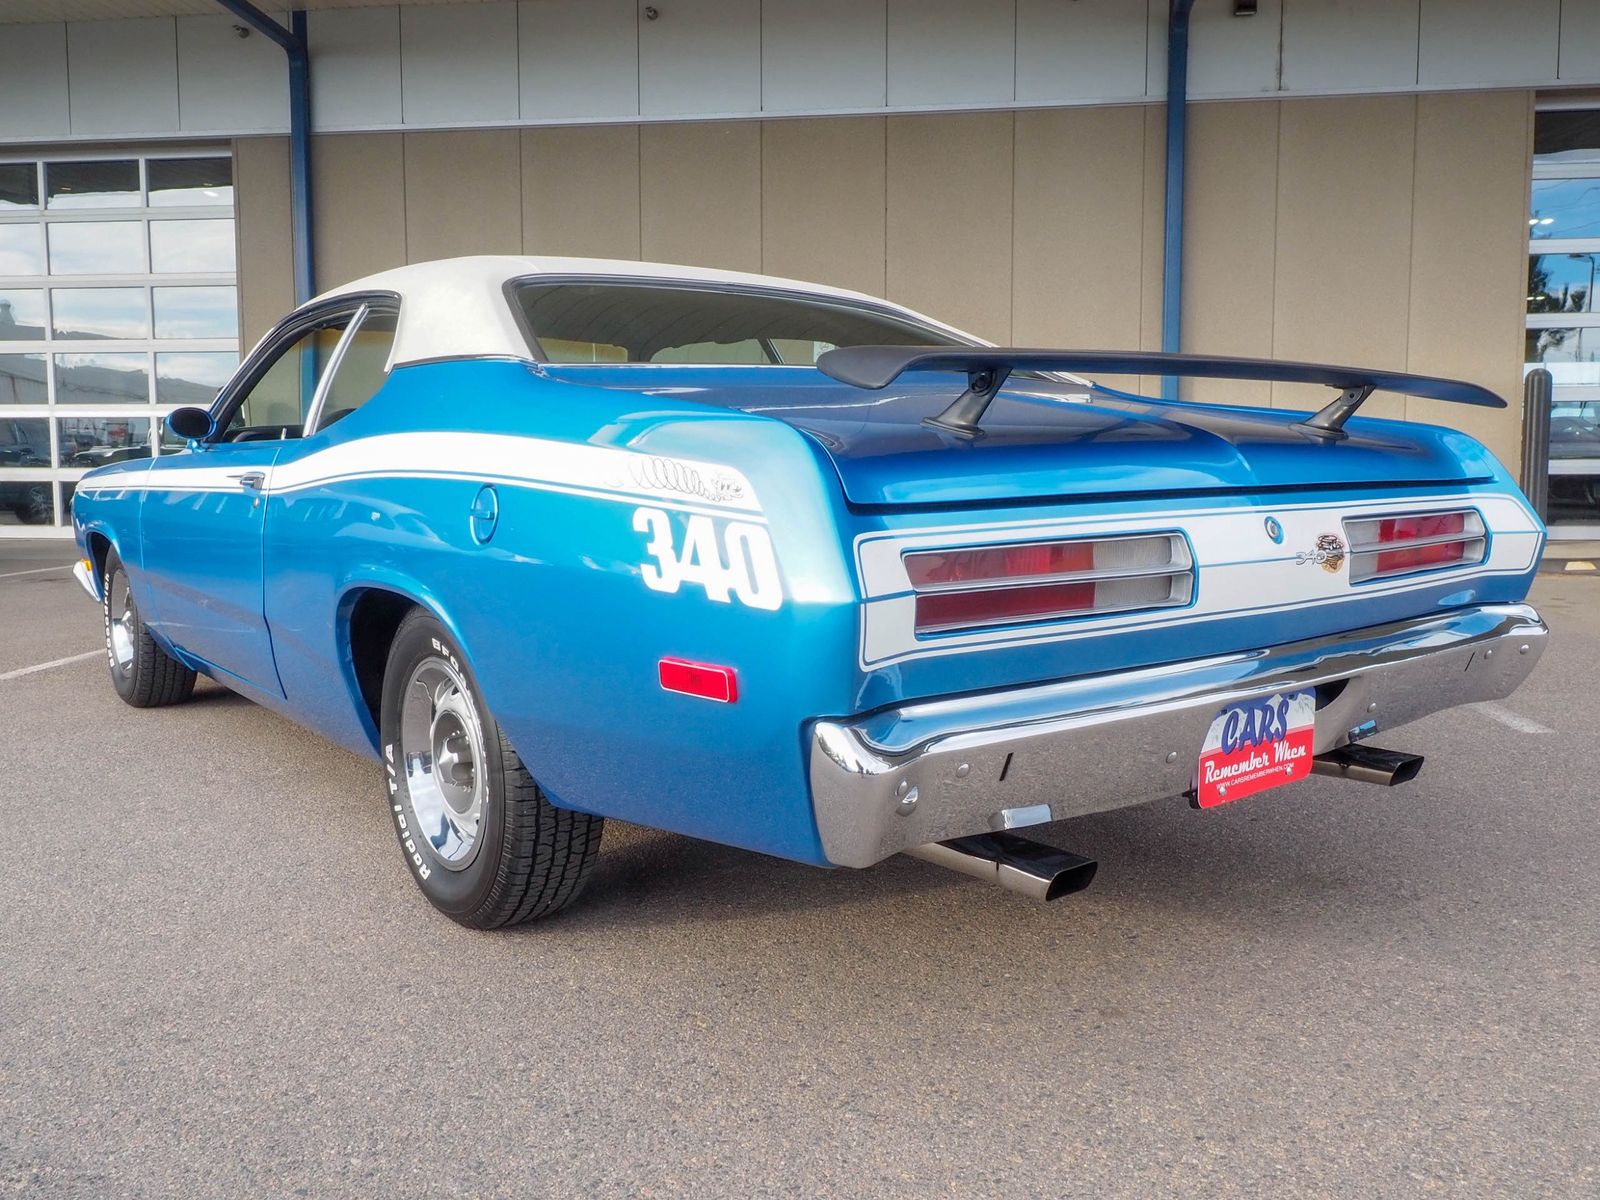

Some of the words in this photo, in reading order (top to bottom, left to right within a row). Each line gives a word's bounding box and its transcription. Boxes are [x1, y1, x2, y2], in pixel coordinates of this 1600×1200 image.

[633, 506, 783, 611] 340
[1295, 549, 1327, 566] 340
[1221, 699, 1290, 755] CARS
[385, 744, 398, 795] T/A
[1205, 751, 1270, 784] Remember
[1273, 740, 1306, 763] When
[394, 804, 431, 880] Radial
